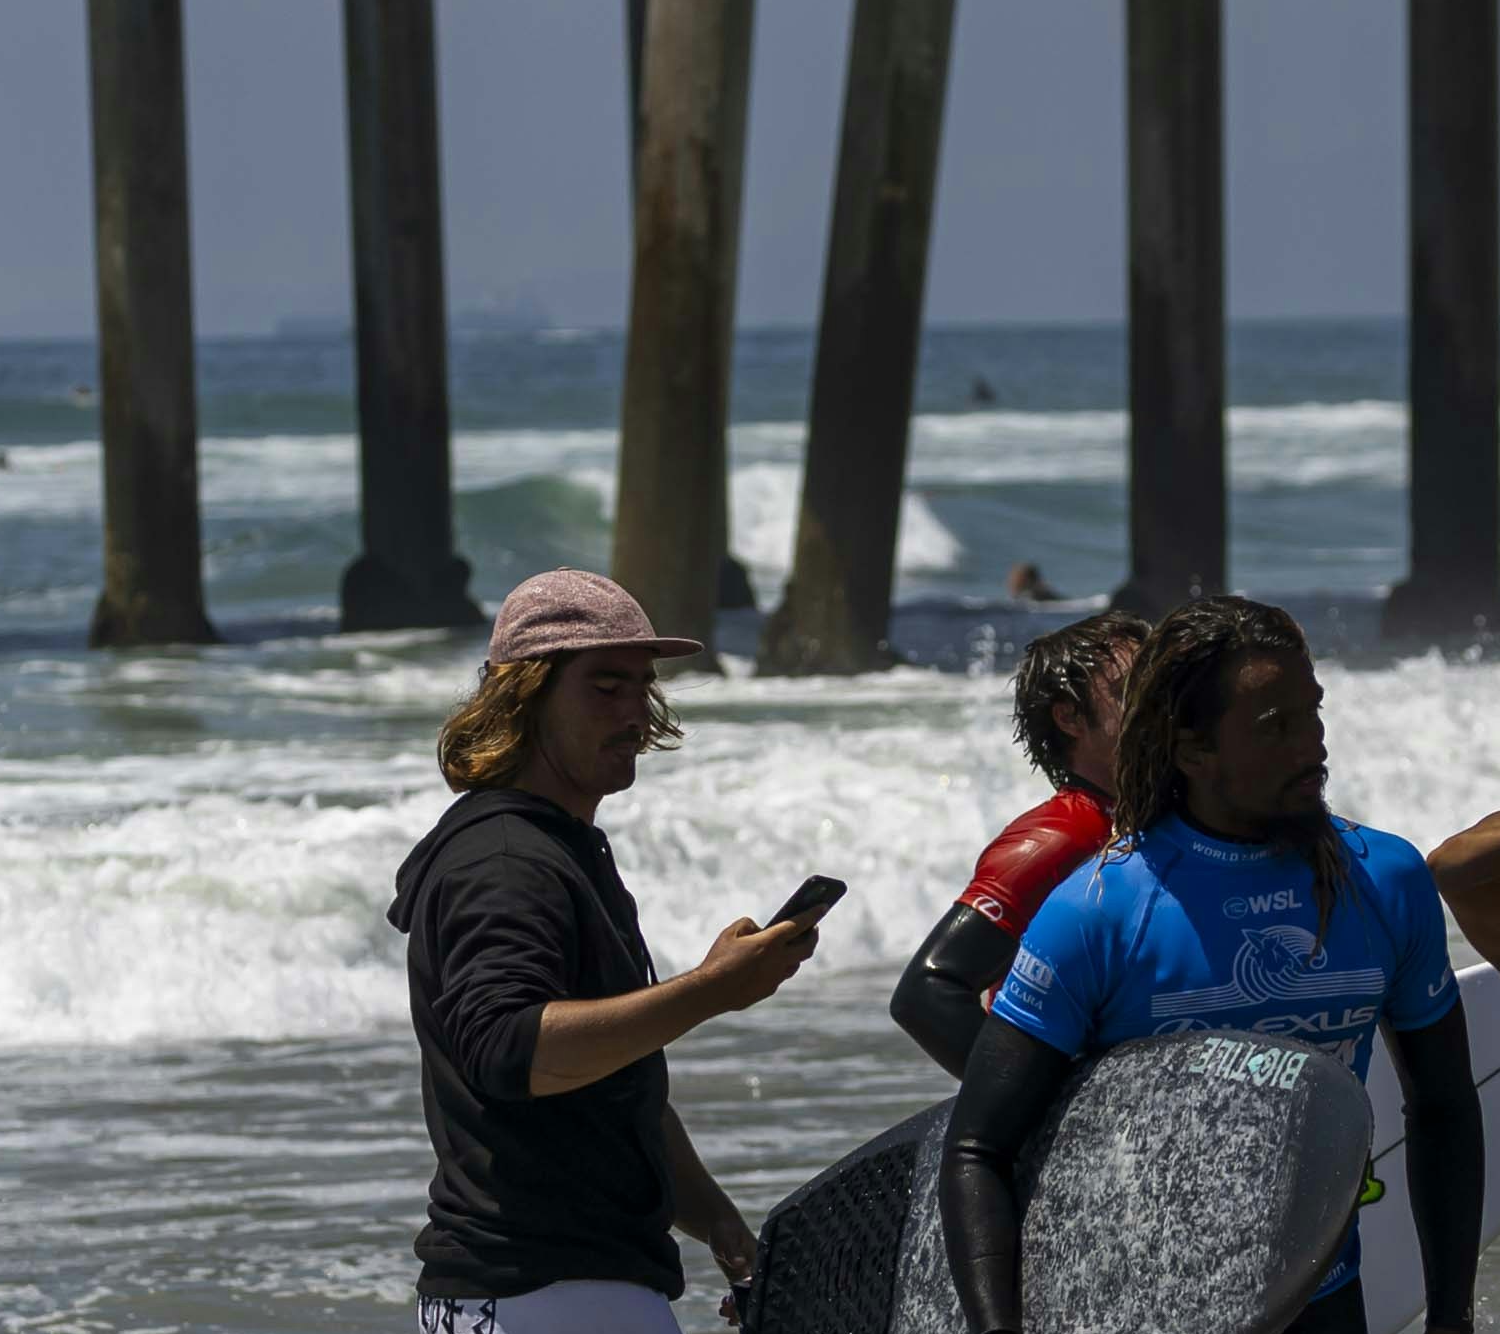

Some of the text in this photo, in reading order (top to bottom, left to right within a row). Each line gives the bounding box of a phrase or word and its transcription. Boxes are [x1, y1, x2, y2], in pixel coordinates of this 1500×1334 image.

[1192, 841, 1239, 862] WORLD
[1247, 888, 1303, 915] WSL
[1009, 980, 1044, 1011] CLARA
[1222, 1005, 1380, 1036] EXUS
